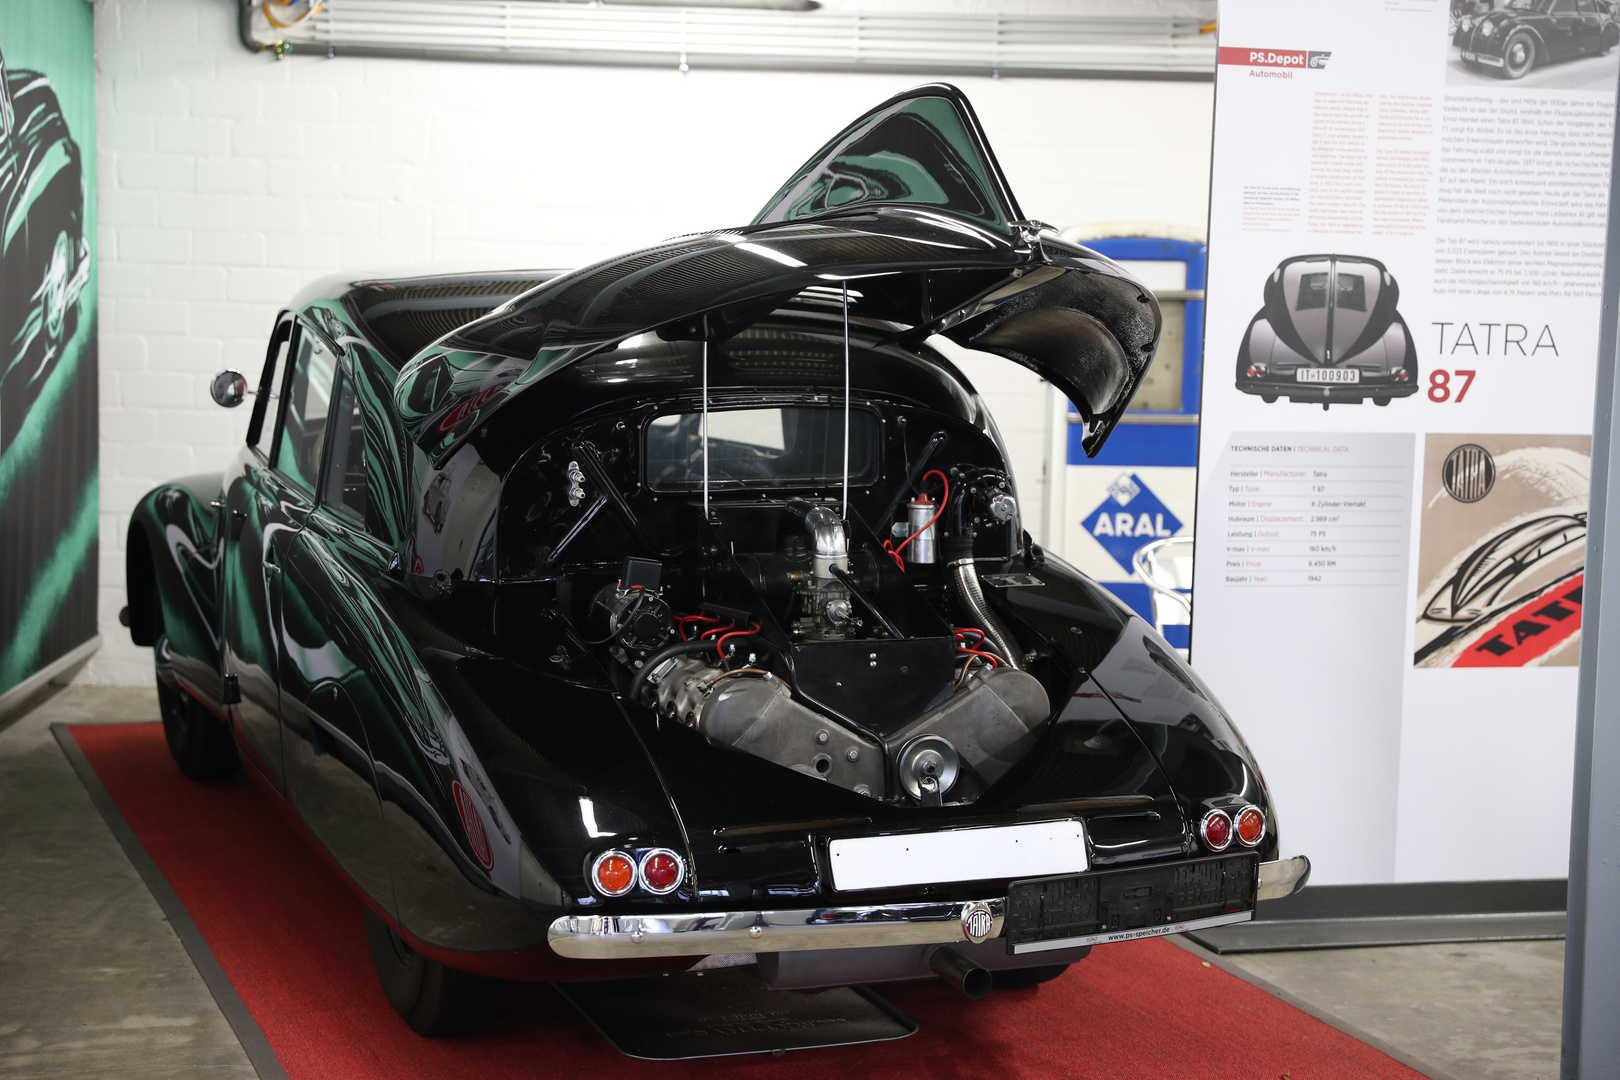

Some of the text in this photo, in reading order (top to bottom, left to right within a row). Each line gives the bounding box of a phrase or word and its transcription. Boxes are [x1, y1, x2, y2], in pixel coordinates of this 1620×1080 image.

[1250, 52, 1304, 66] PS.Depot
[1249, 70, 1293, 78] Automobil
[1432, 322, 1558, 356] TATRA
[1317, 370, 1355, 381] 100903
[1427, 369, 1476, 403] 87
[1093, 512, 1171, 537] ARAL
[967, 910, 991, 937] TATRA
[1108, 927, 1170, 941] www.ps-speicher.de
